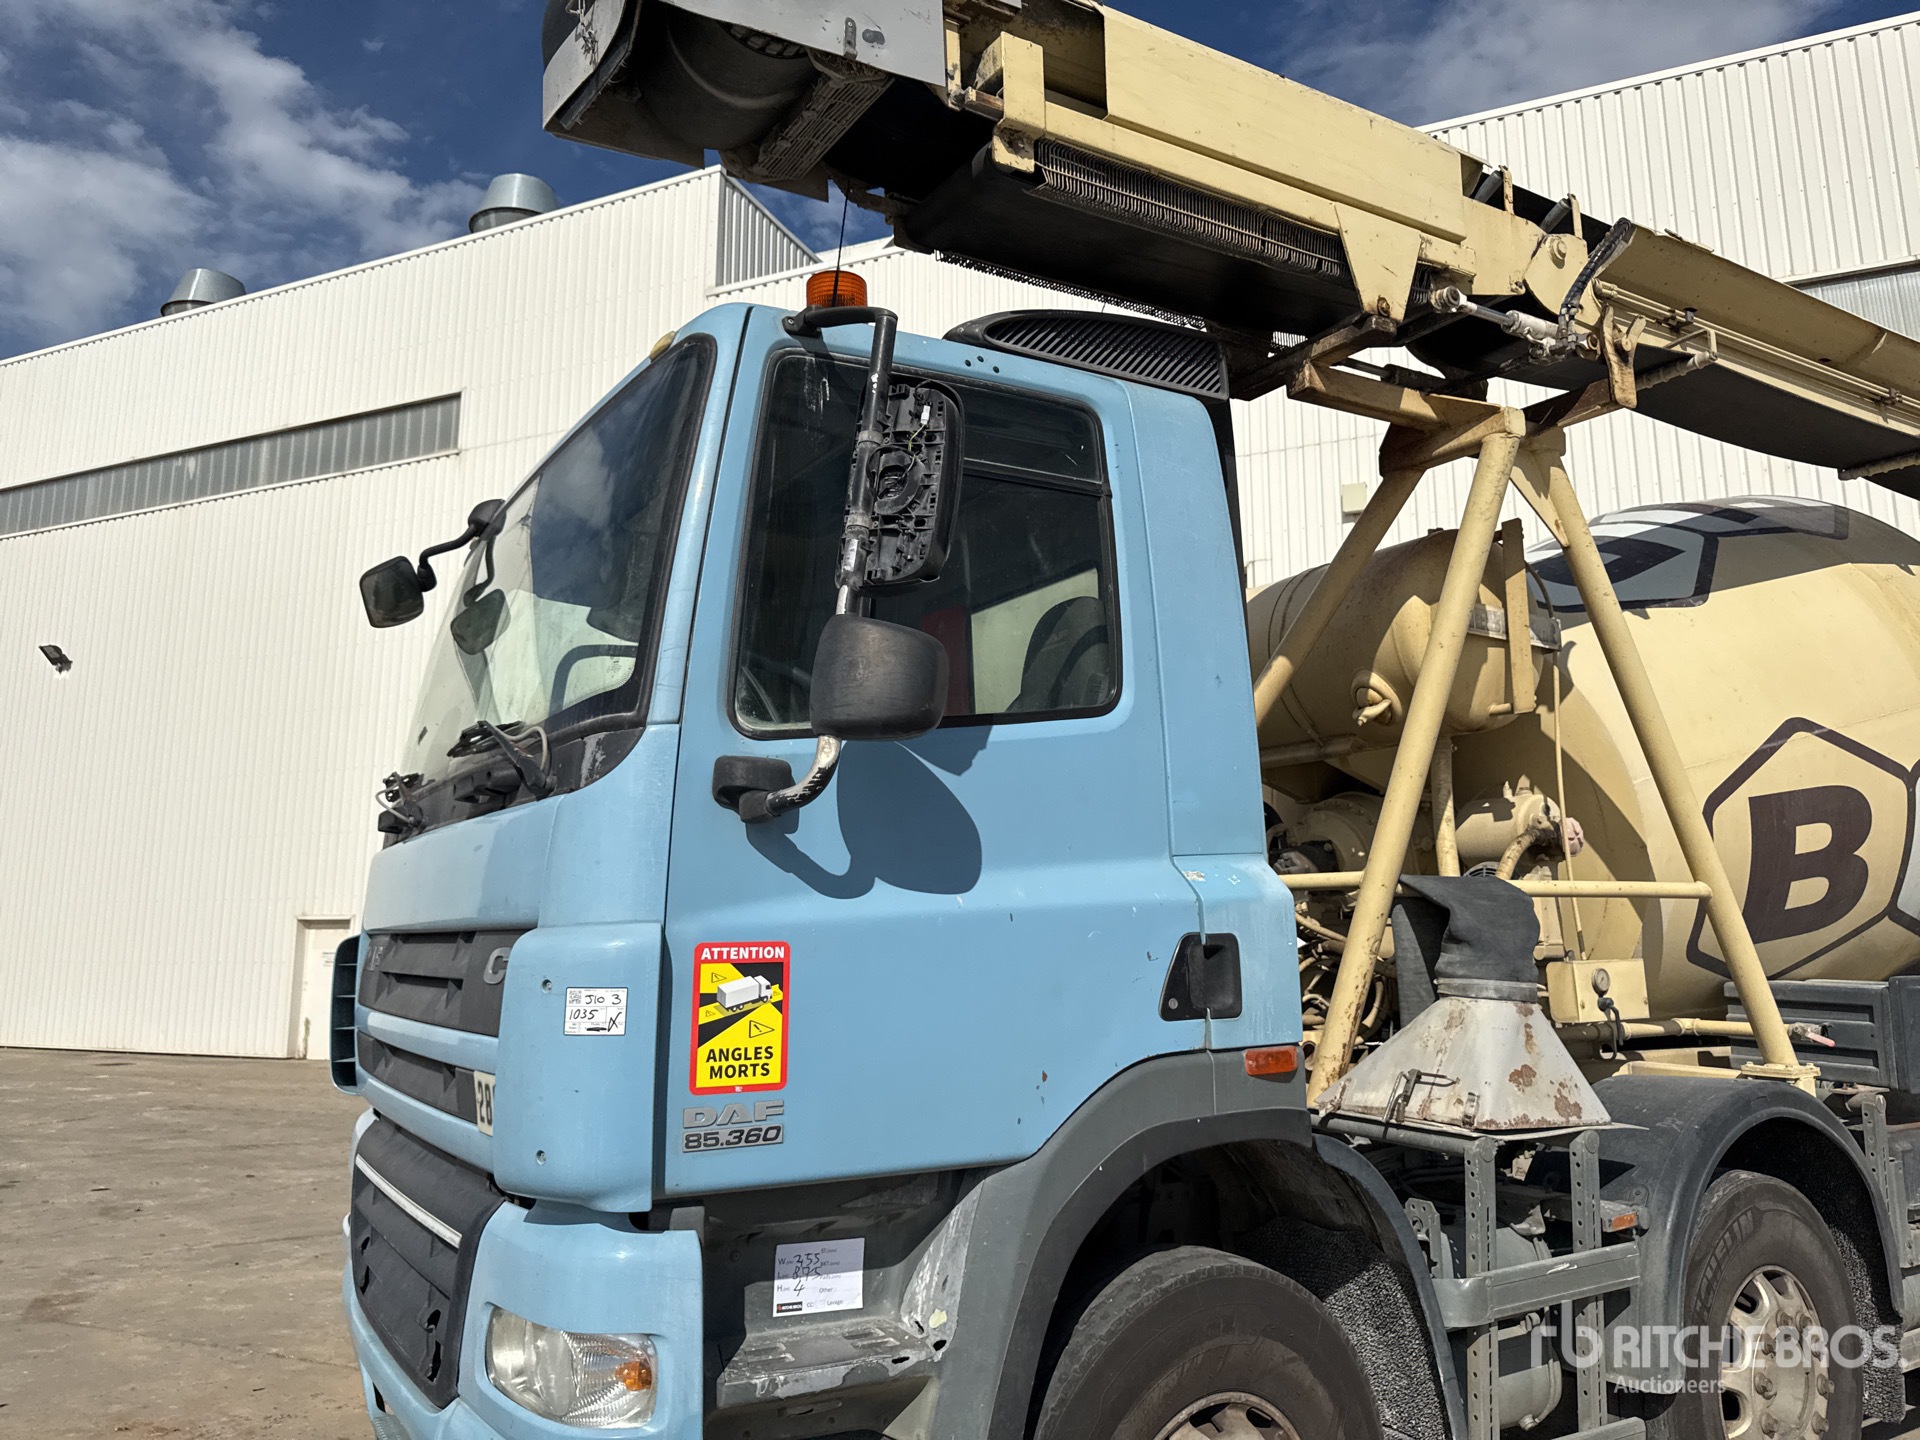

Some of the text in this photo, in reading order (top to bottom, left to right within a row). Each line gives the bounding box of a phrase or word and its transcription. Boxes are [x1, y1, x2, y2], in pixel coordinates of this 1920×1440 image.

[1742, 785, 1873, 945] B
[700, 946, 785, 960] ATTENTION
[569, 1008, 599, 1021] 1035
[706, 1045, 774, 1063] ANGLES
[709, 1062, 770, 1080] MORTS
[476, 1080, 496, 1126] 28
[683, 1100, 785, 1129] DAF
[684, 1124, 782, 1150] 85.360
